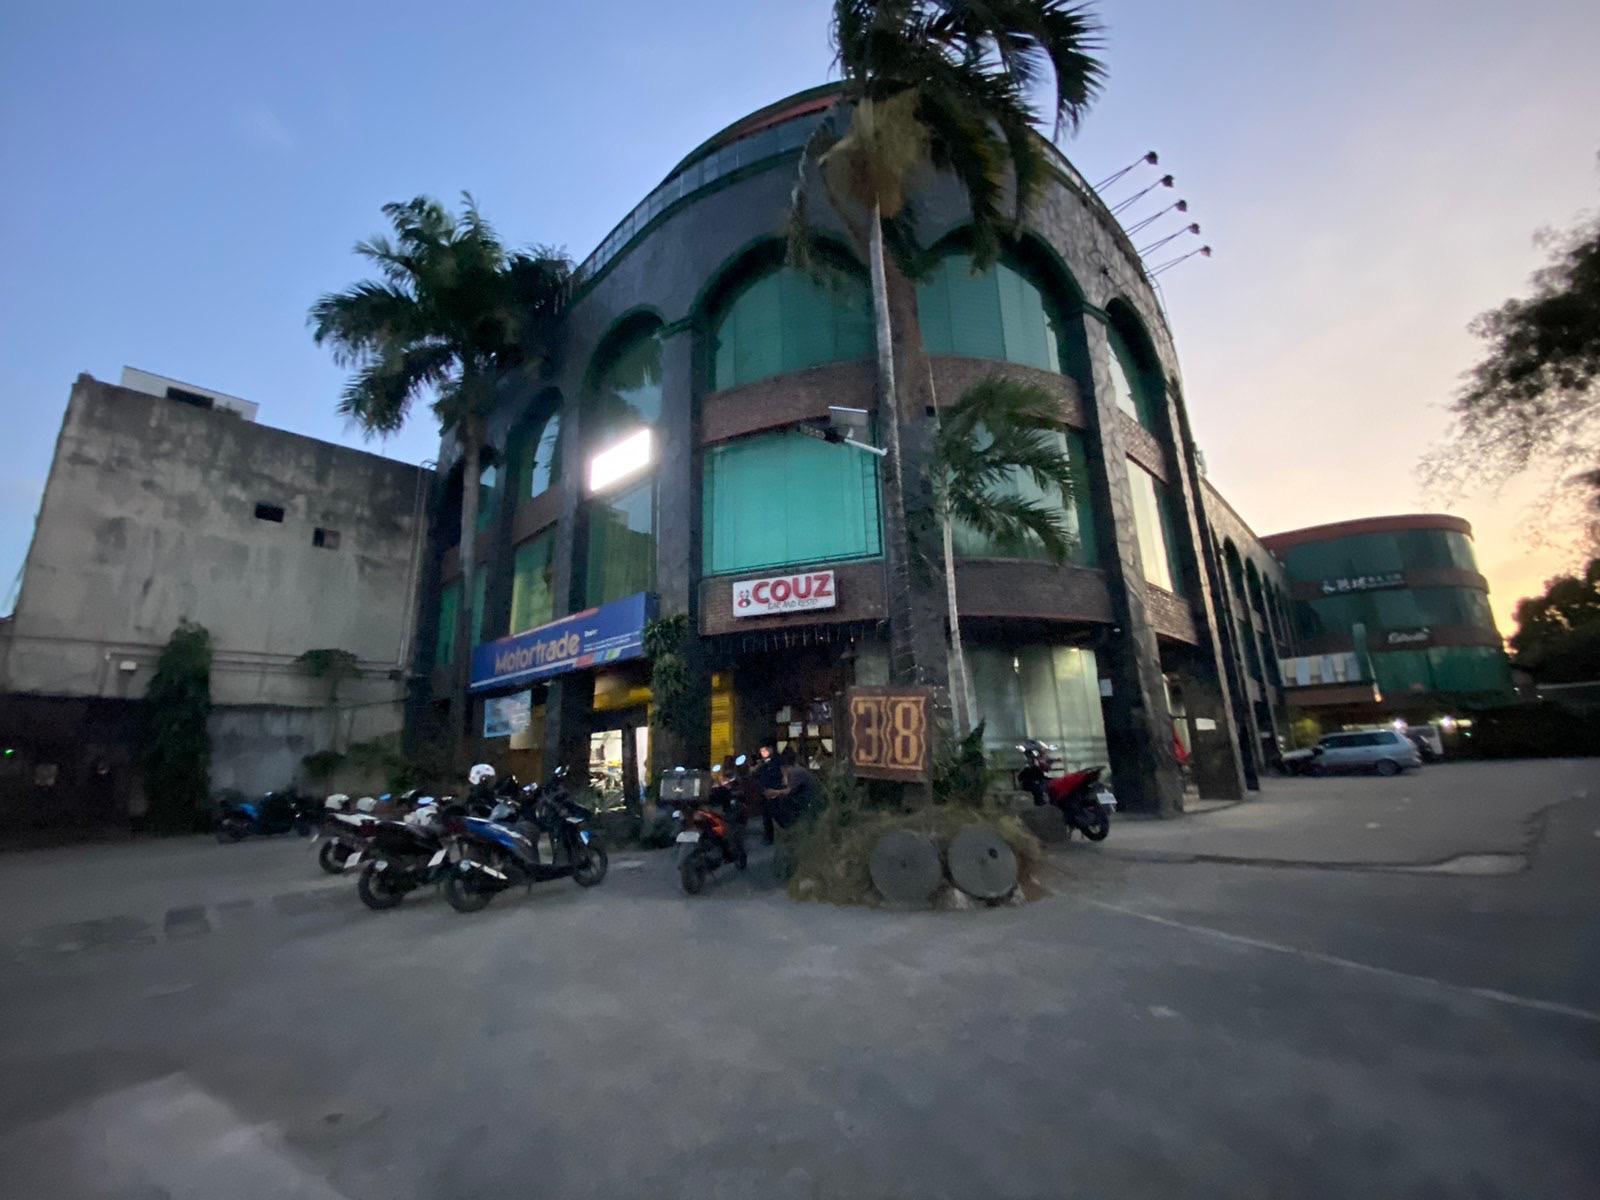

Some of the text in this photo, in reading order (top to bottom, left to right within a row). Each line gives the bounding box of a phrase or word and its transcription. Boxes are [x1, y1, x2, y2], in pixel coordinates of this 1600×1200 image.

[752, 574, 832, 604] COUZ
[494, 630, 581, 675] Motortrade
[857, 701, 920, 764] 38
